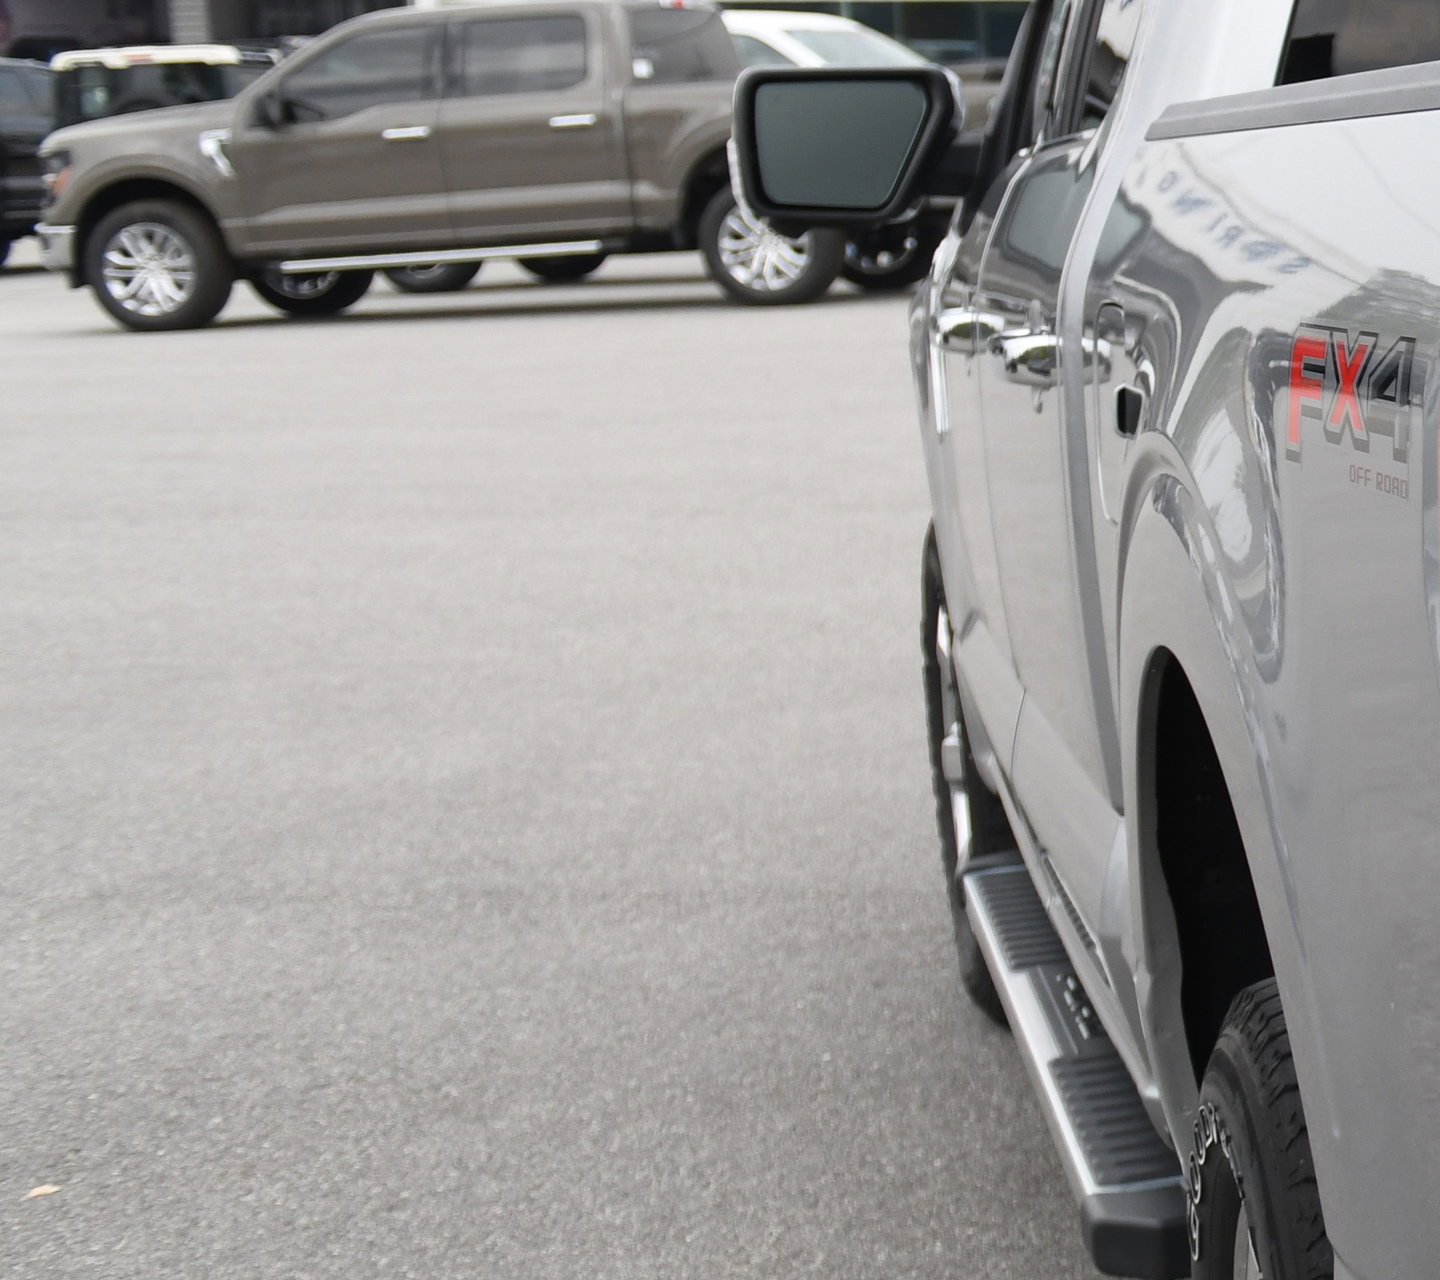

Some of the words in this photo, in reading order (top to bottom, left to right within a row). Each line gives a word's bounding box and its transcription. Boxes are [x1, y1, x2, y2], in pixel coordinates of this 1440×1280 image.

[1285, 322, 1416, 464] FX4
[1349, 464, 1371, 488] OFF
[1376, 471, 1409, 499] ROAD
